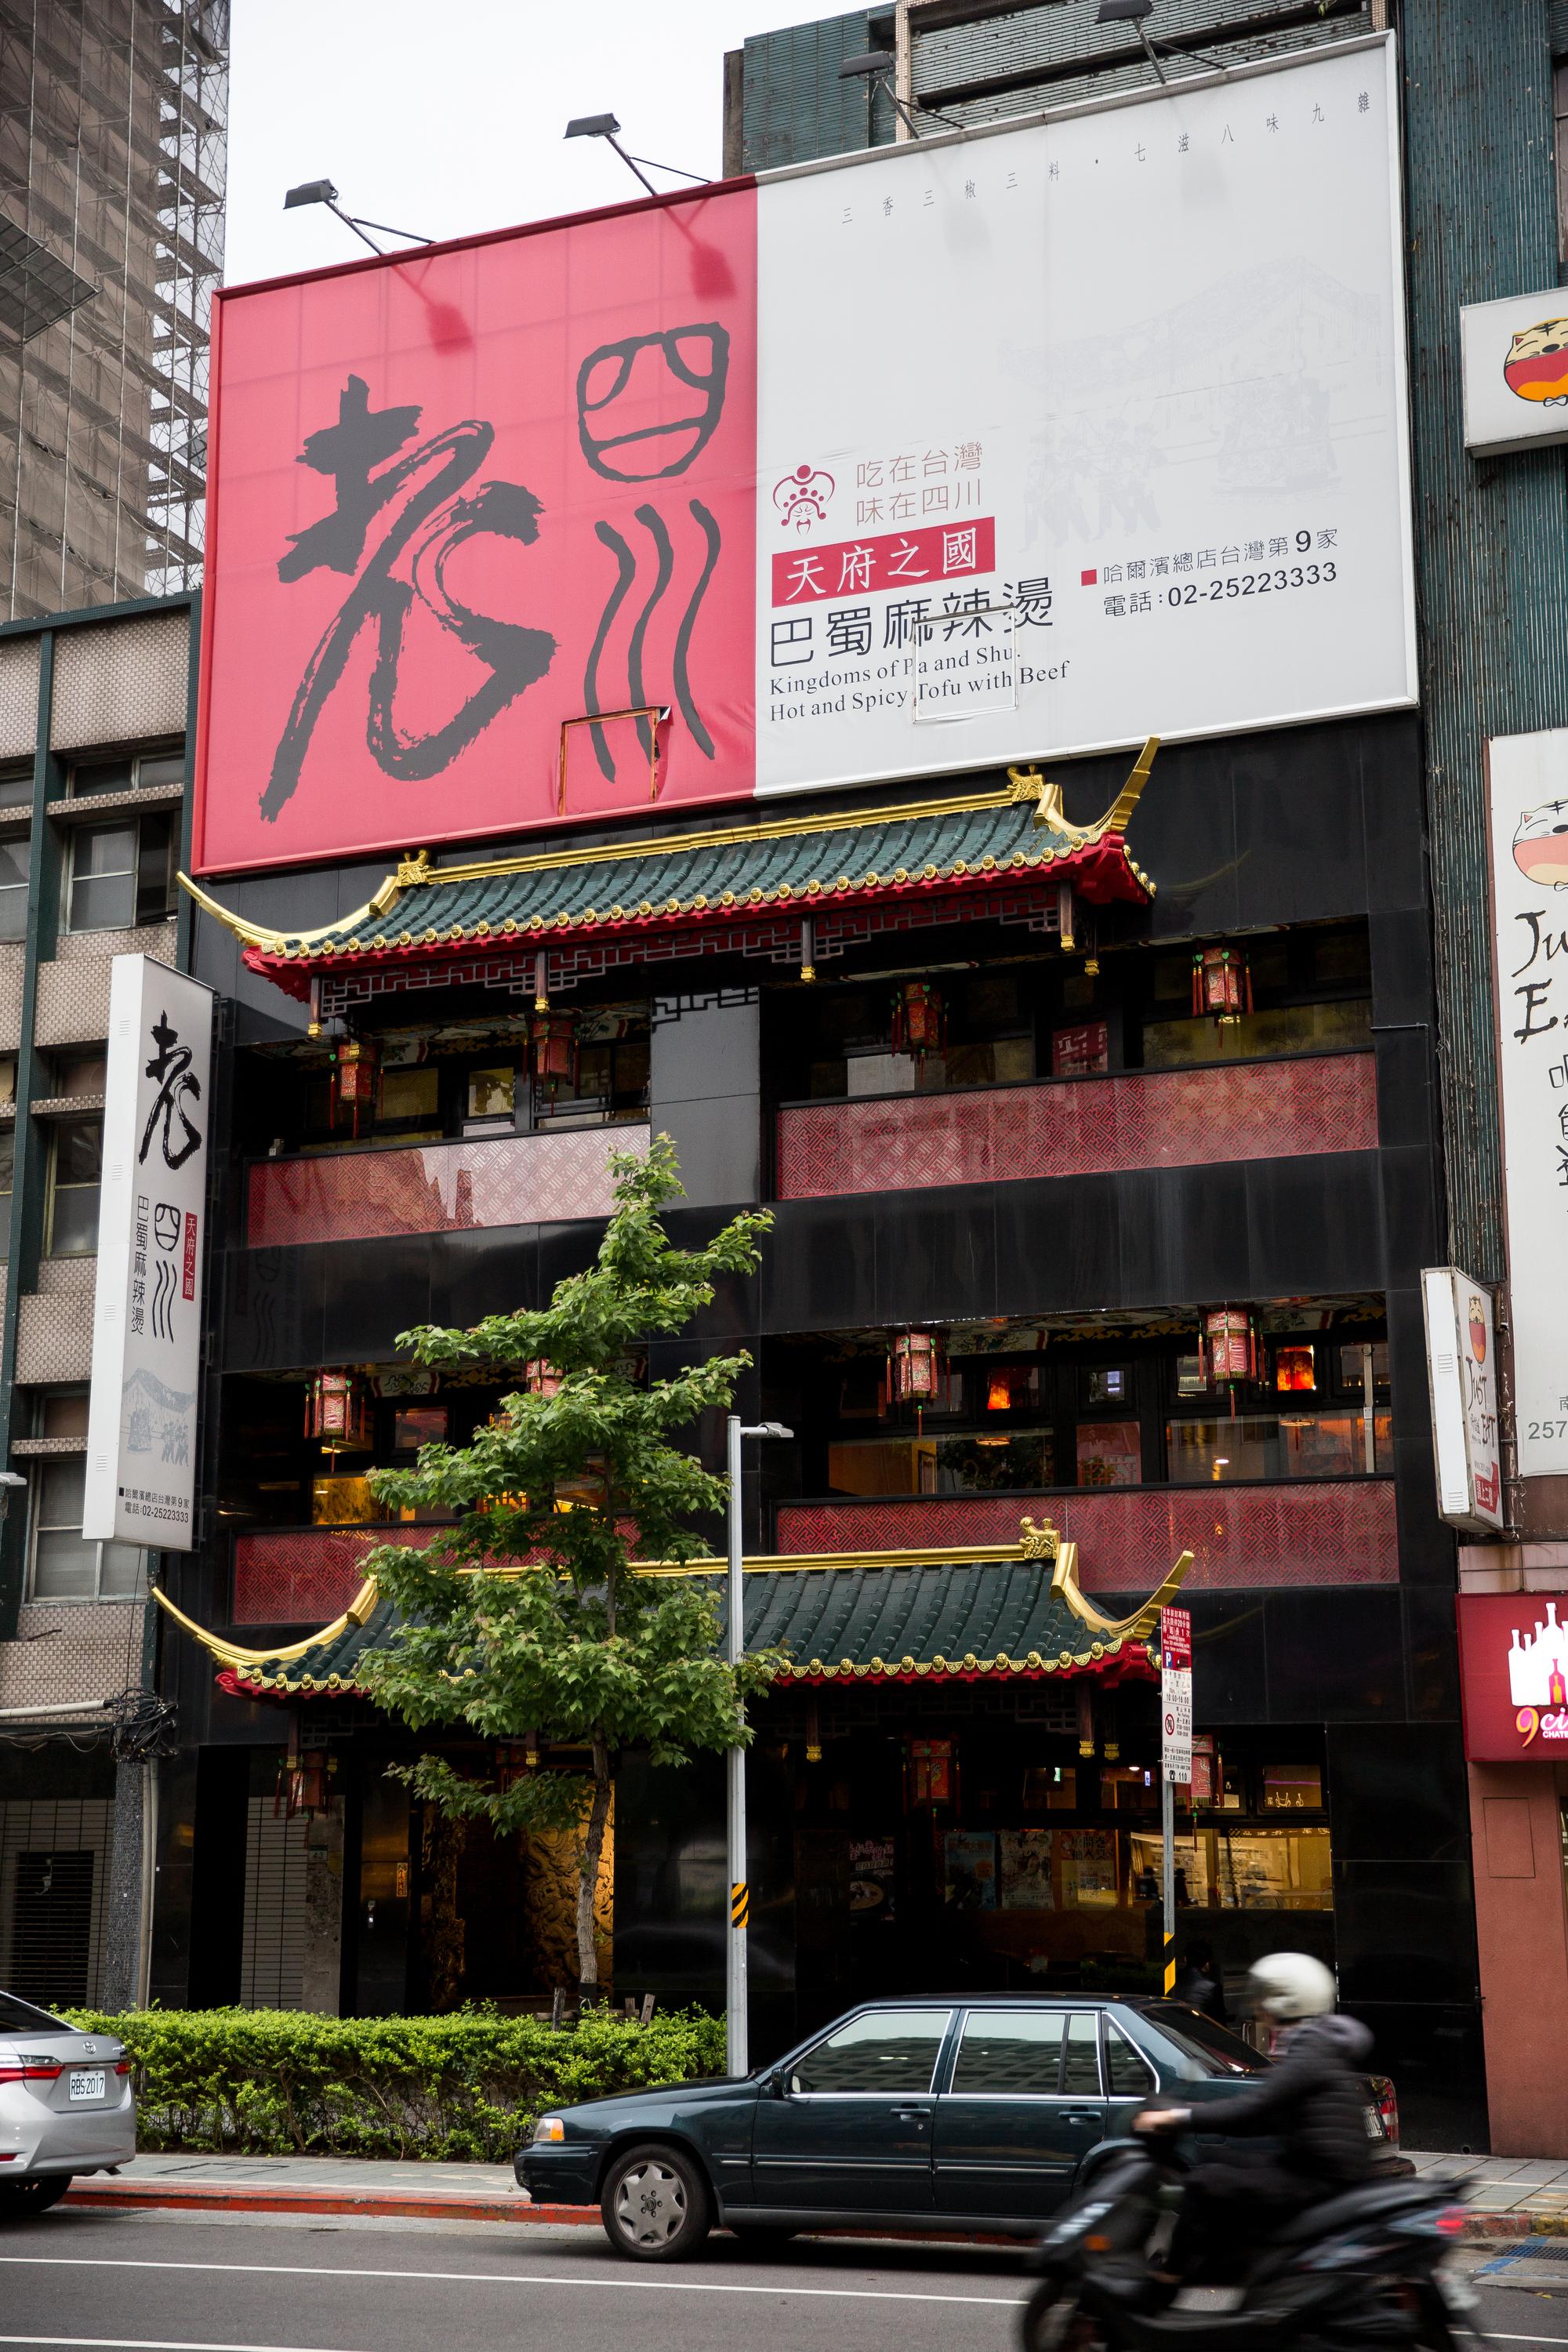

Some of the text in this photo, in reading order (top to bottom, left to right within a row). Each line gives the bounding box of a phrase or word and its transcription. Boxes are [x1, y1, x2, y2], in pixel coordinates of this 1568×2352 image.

[857, 441, 982, 488] 吃在台灣
[857, 478, 981, 527] 味在四川
[786, 527, 976, 601] 天府之國
[1103, 528, 1338, 584] 哈爾濱總店台灣第9家
[771, 577, 1053, 667] 巴蜀麻辣燙
[769, 669, 871, 695] Kingdoms
[877, 659, 900, 680] of
[935, 650, 969, 671] and
[770, 660, 1070, 721] Hot and Spicy Tofu with Beef
[131, 1195, 149, 1335] 巴蜀麻辣燙
[185, 1217, 196, 1296] 天府之國
[1165, 1651, 1171, 1667] P
[1178, 1772, 1188, 1782] 110
